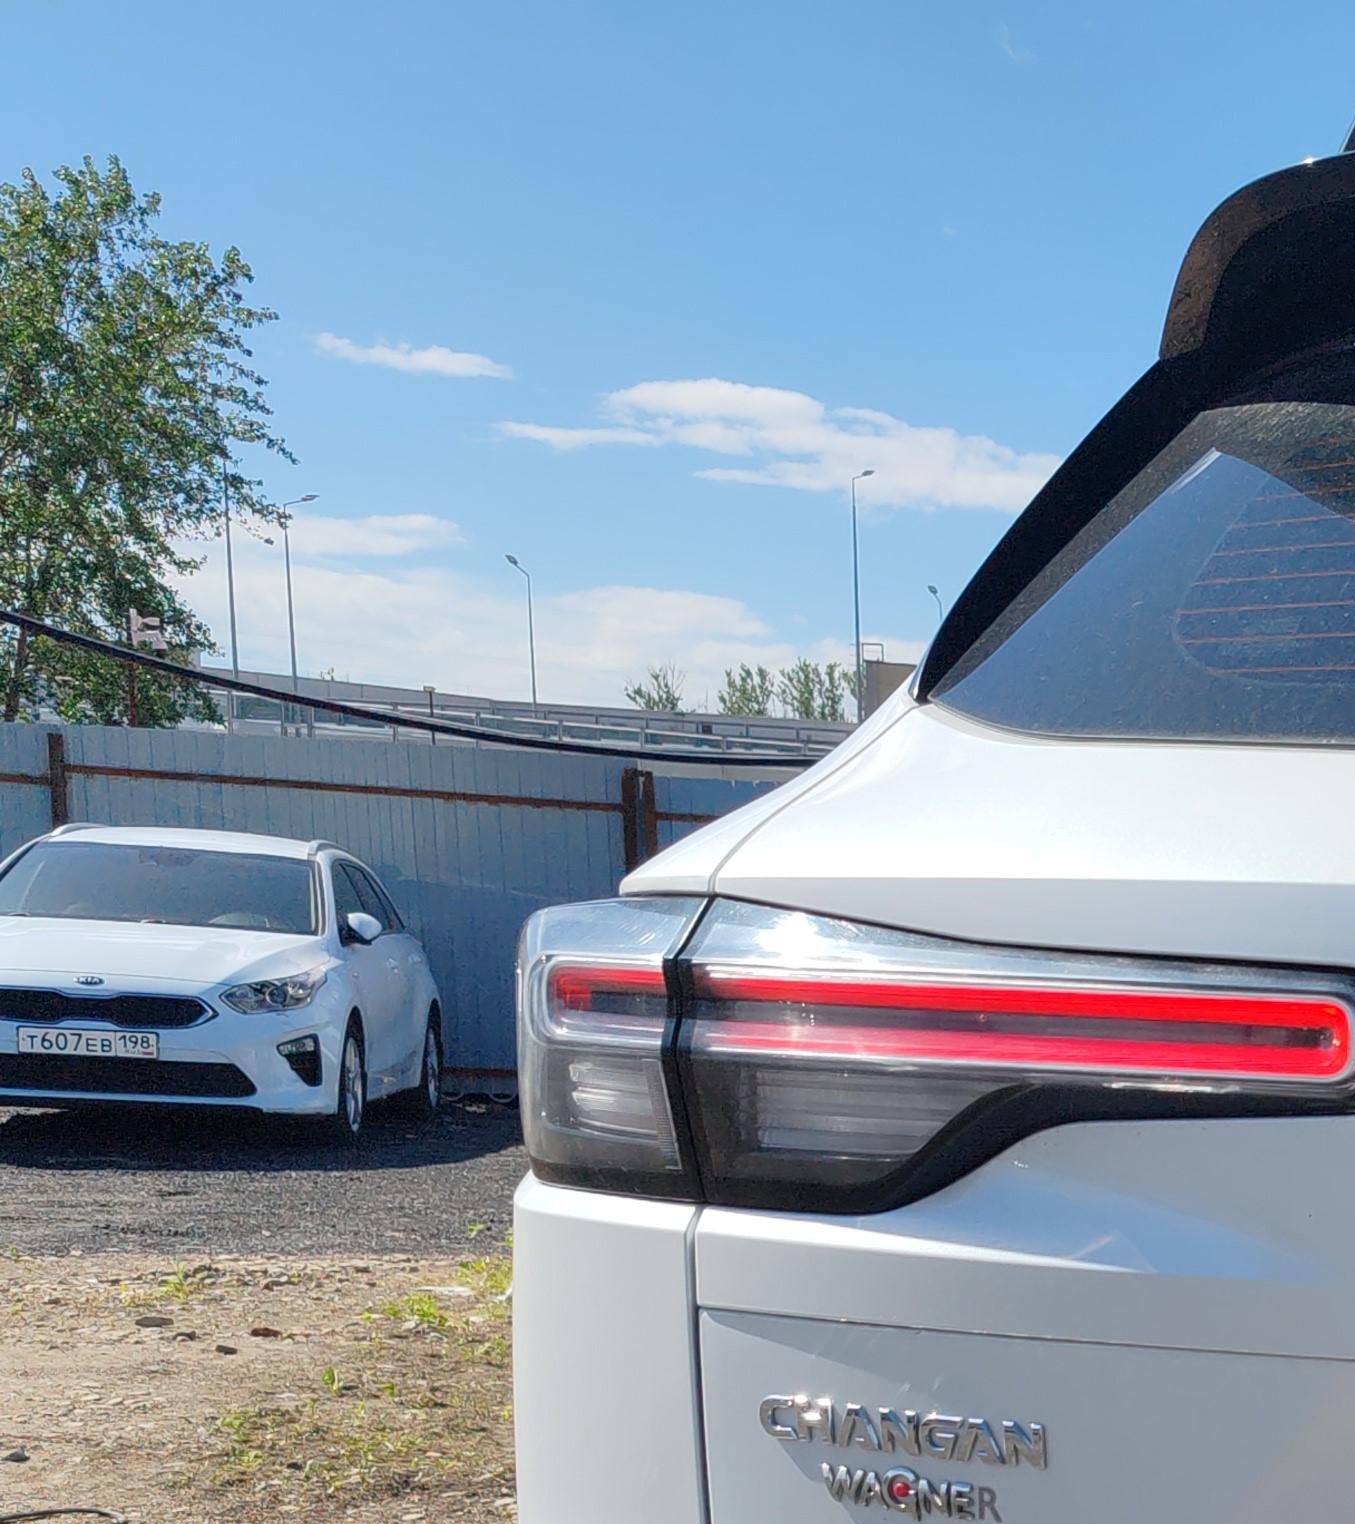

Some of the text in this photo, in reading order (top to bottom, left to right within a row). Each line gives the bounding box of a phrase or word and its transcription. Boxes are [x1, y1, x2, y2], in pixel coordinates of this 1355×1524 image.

[118, 1034, 150, 1049] 198
[759, 1394, 1048, 1470] CHANGAN
[820, 1461, 1003, 1523] WAGNER
